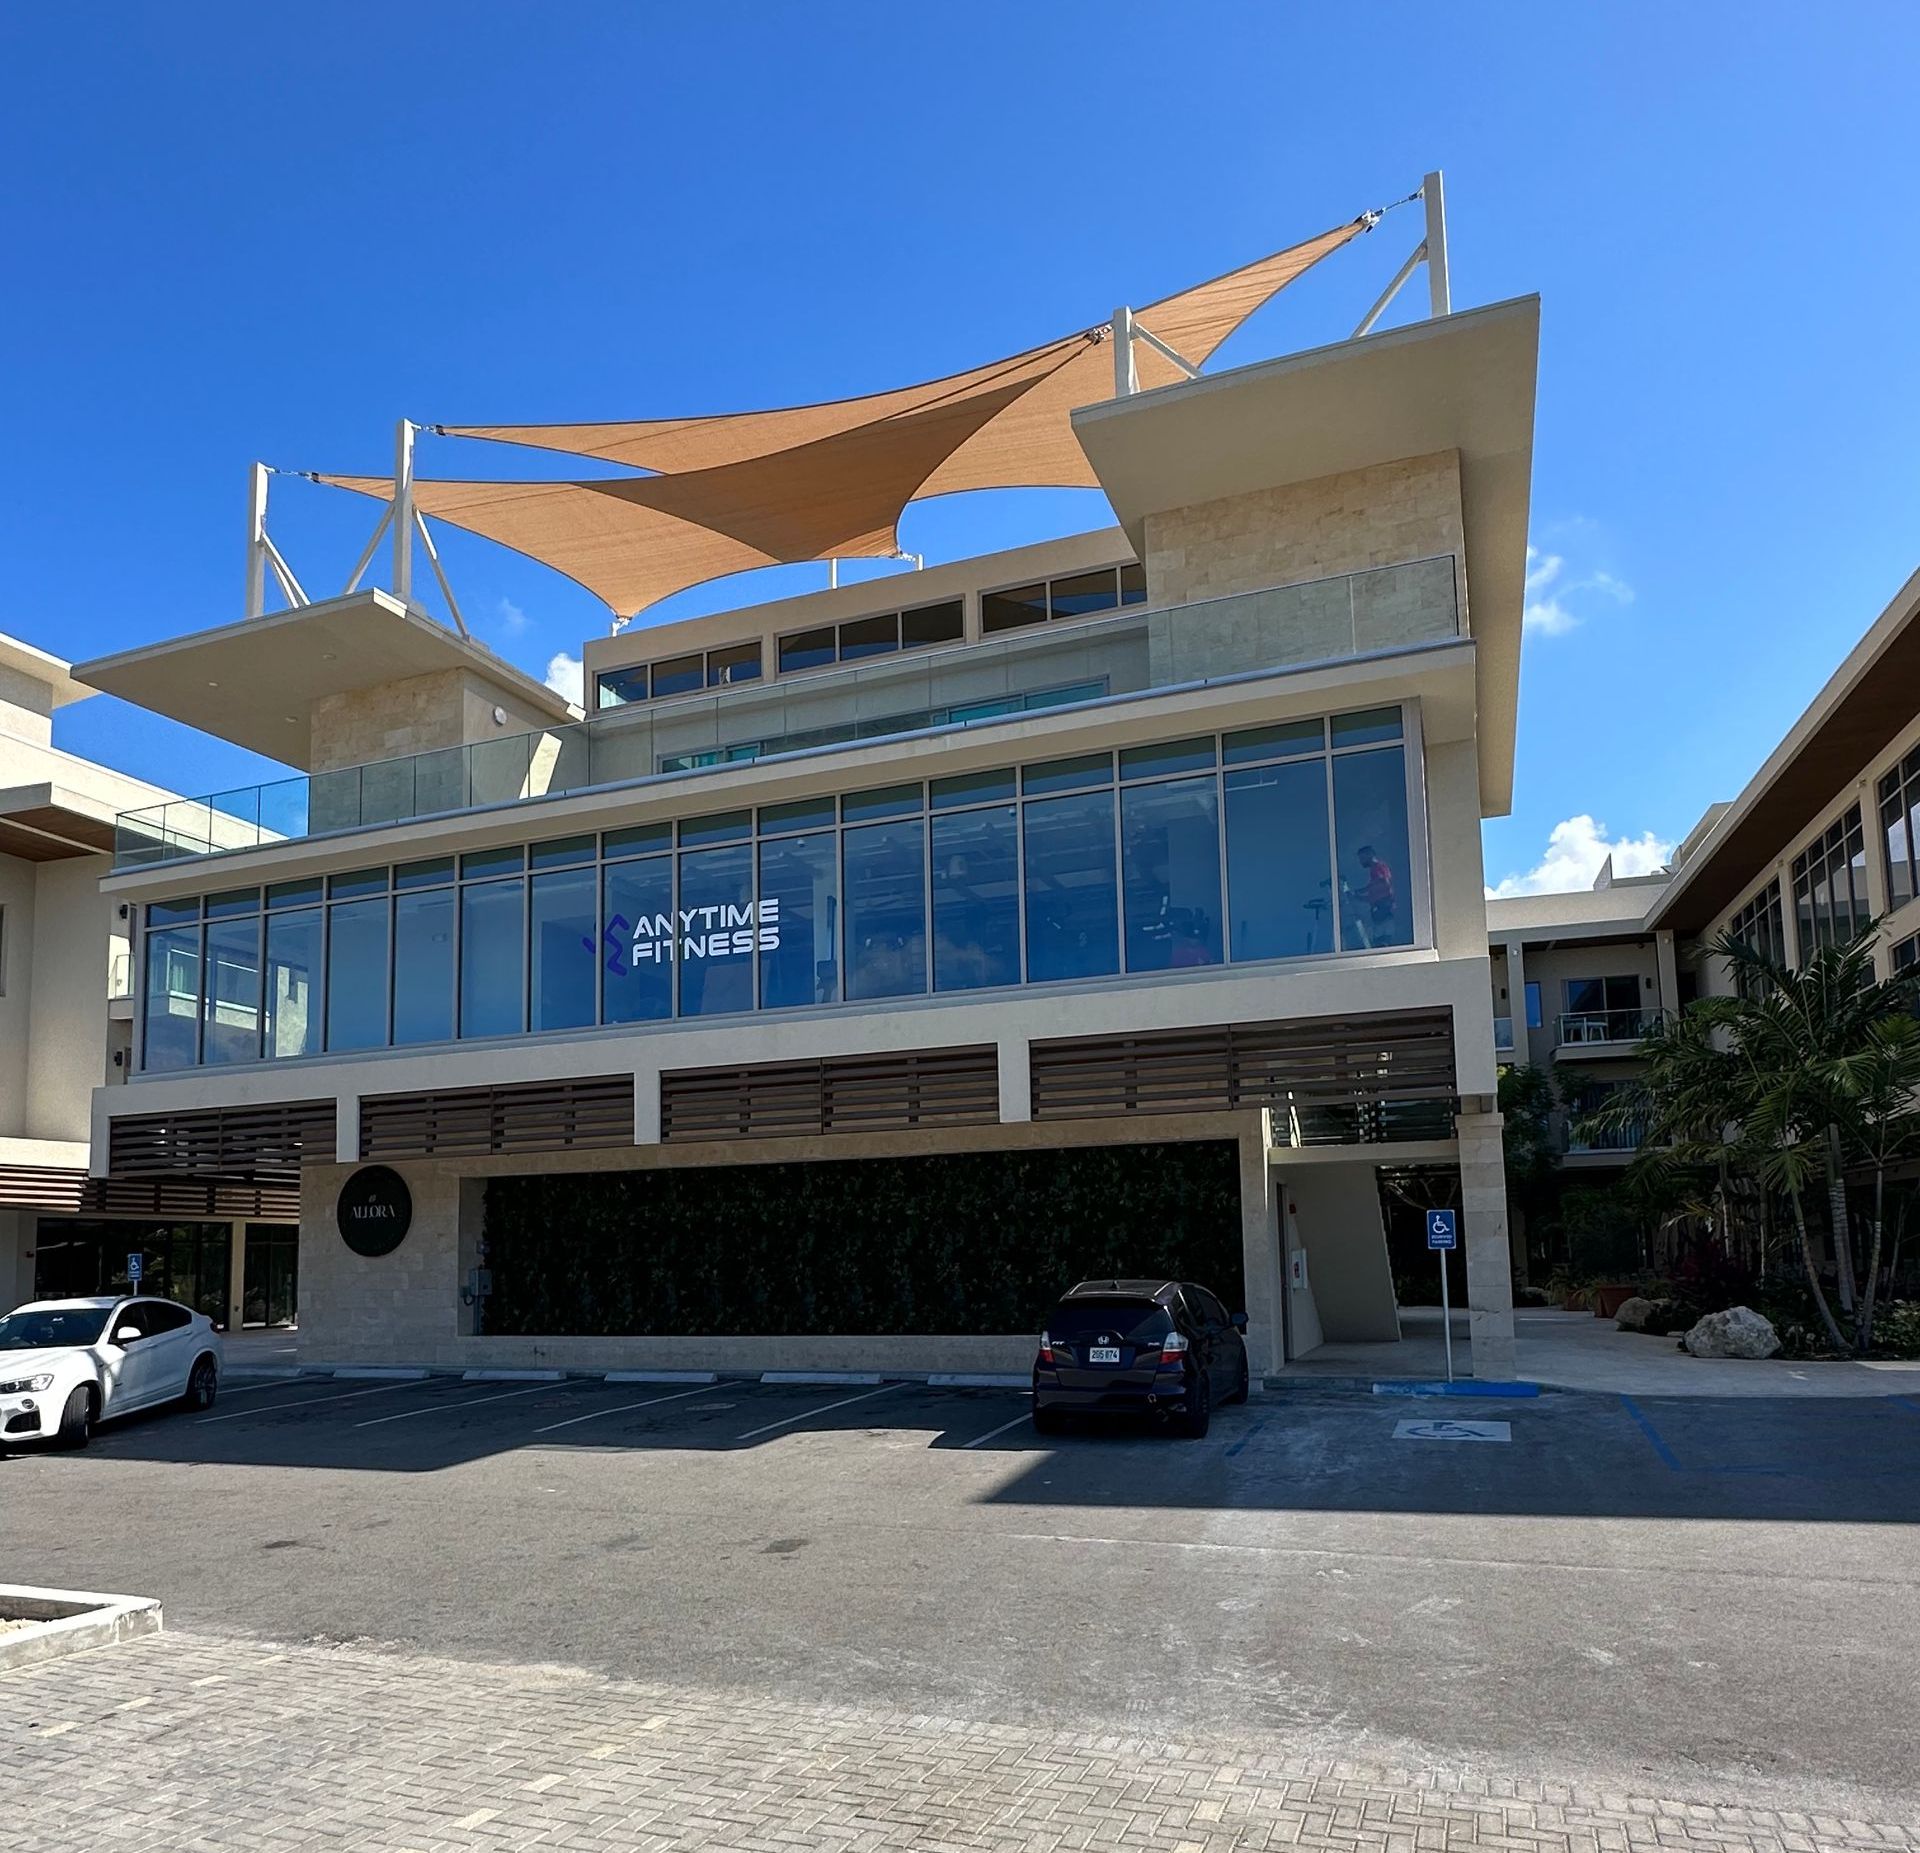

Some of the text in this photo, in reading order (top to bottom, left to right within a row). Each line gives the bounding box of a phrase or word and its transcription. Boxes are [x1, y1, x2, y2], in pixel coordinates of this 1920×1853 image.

[632, 898, 779, 939] ANYTIME
[632, 926, 780, 967] FITNESS
[352, 1204, 395, 1219] ALLORA
